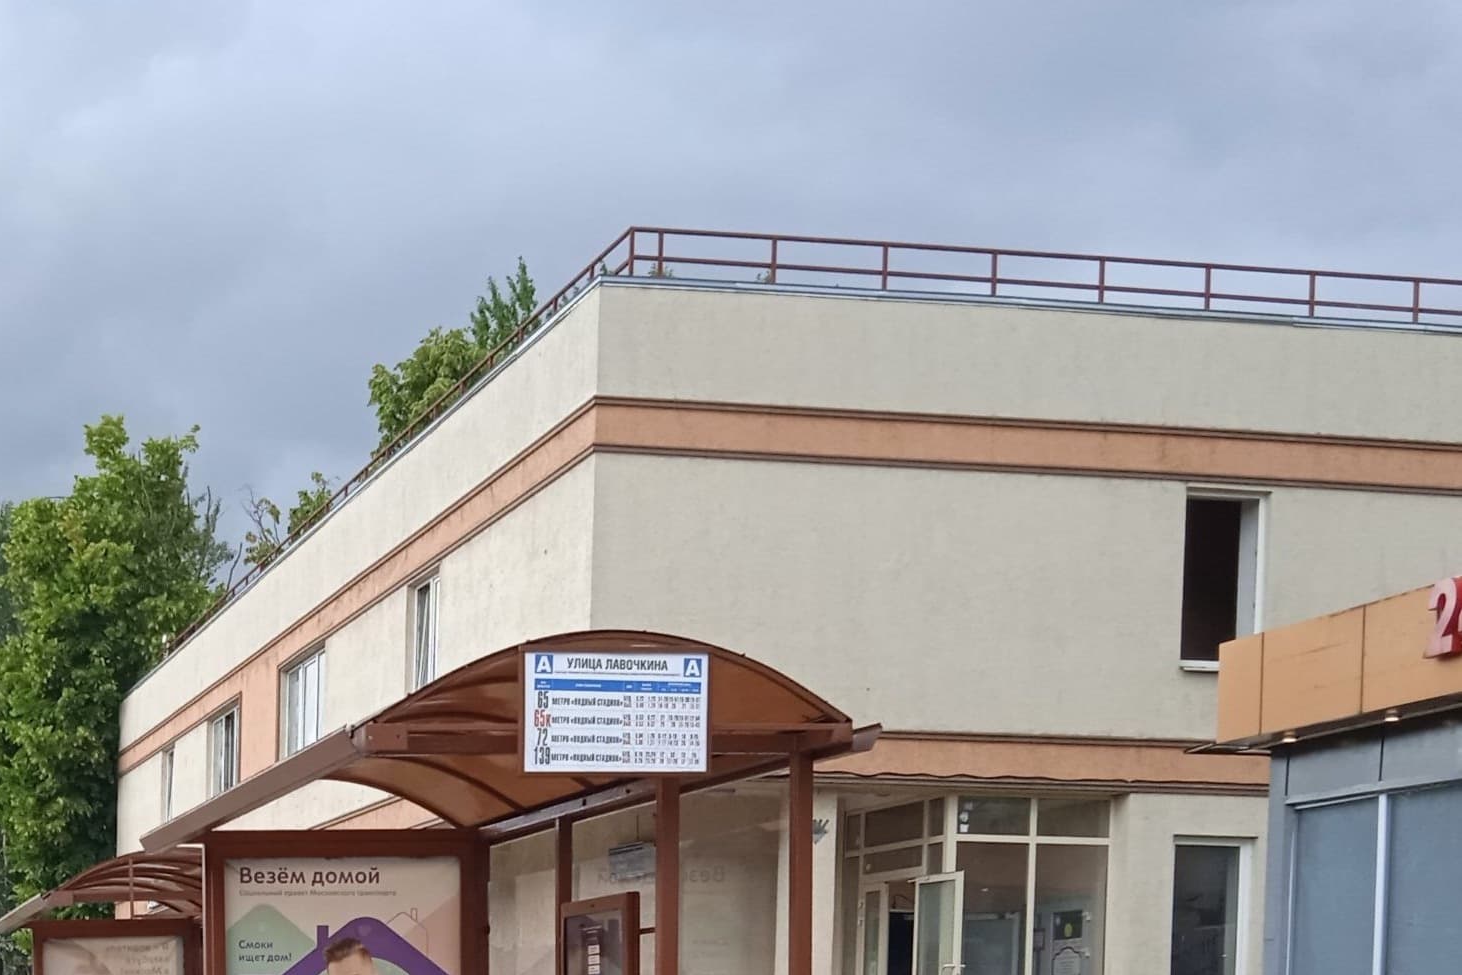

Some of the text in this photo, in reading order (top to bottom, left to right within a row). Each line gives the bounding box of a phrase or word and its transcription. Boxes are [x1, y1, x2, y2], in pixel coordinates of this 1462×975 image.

[1428, 578, 1461, 656] 2
[567, 657, 668, 671] УЛИЦА ЛАВОЧКИНА
[537, 690, 549, 708] 65
[537, 728, 548, 746] 72
[534, 746, 551, 765] 139
[239, 866, 380, 887] Везём домой
[239, 940, 273, 950] Смоки
[239, 953, 292, 963] ищет дом!
